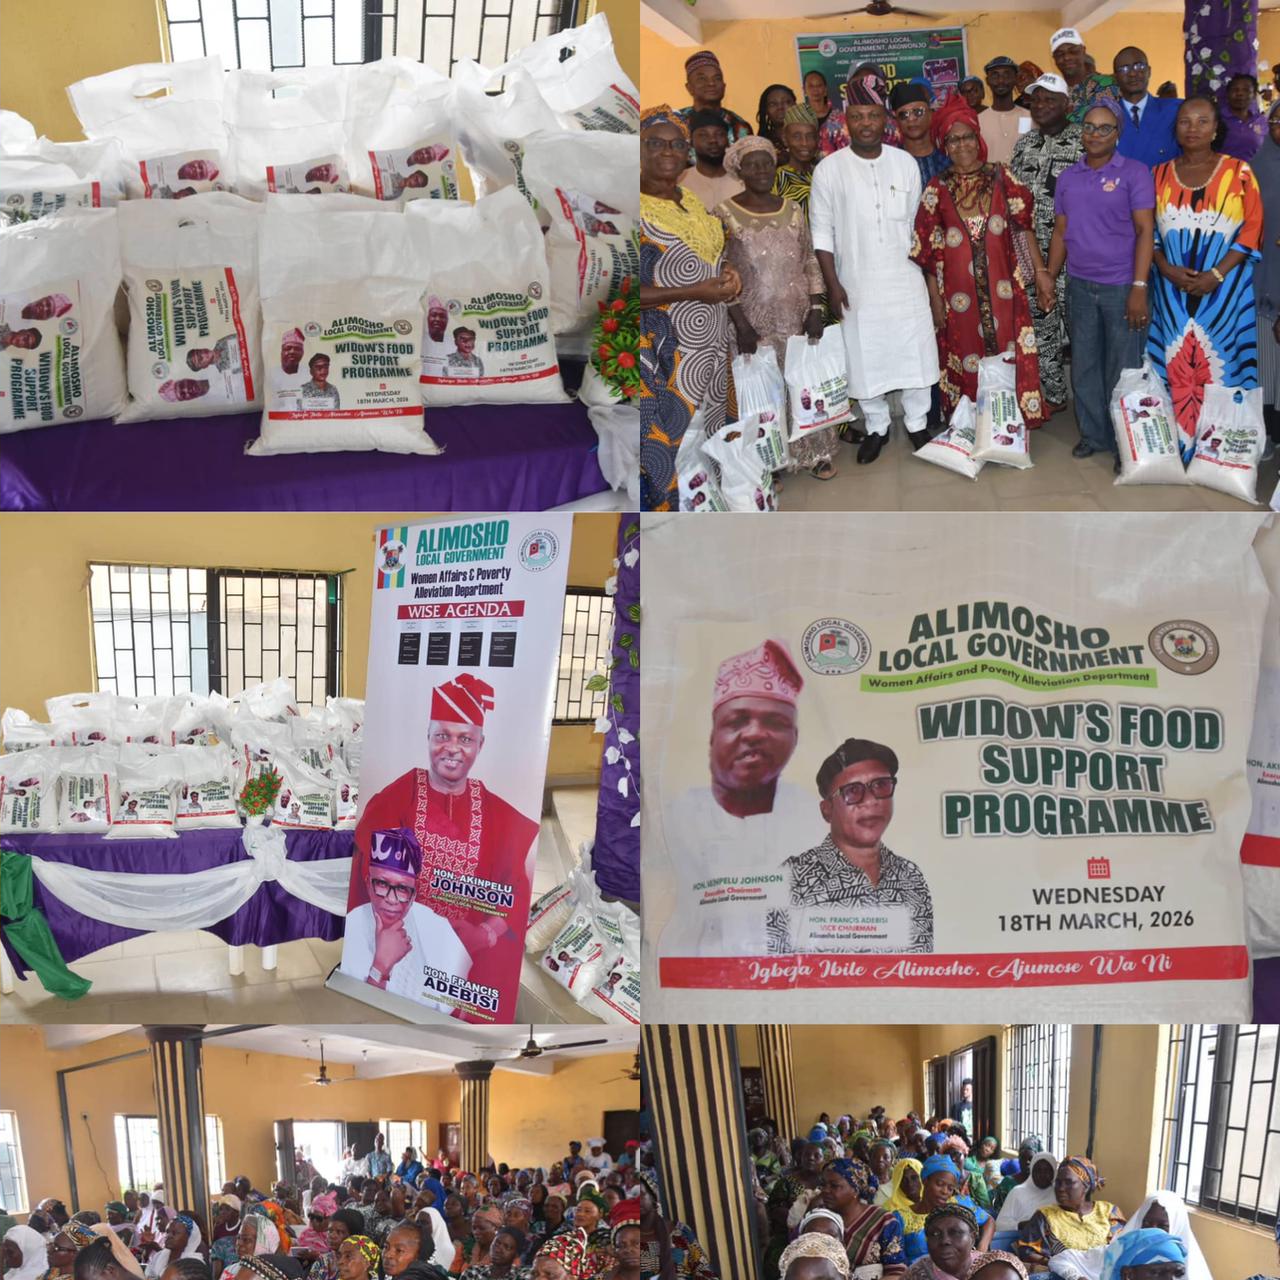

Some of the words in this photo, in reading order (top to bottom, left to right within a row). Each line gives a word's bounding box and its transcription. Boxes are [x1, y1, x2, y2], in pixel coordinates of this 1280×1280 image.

[182, 287, 197, 330] SUPPORT
[192, 280, 209, 337] PROGRAMME
[471, 292, 523, 304] ALIMOSHO
[146, 296, 158, 352] ALIMOSHO
[324, 327, 345, 336] LOCAL
[347, 324, 393, 335] GOVERNMENT
[331, 316, 384, 329] ALIMOSHO
[479, 316, 527, 329] WIDOW'S
[527, 308, 549, 322] FOOD
[495, 323, 540, 340] SUPPORT
[62, 338, 70, 360] LOCAL
[158, 336, 166, 360] LOCAL
[335, 342, 384, 354] WIDOW'S
[386, 343, 413, 354] FOOD
[352, 354, 399, 366] SUPPORT
[71, 345, 82, 398] ALIMOSHO
[342, 367, 412, 378] PROGRAMME
[10, 358, 26, 420] PROGRAMME
[24, 368, 38, 412] SUPPORT
[416, 519, 510, 554] ALIMOSHO
[416, 551, 441, 566] LOCAL
[444, 547, 506, 564] GOVERNMENT
[411, 571, 438, 585] Women
[439, 570, 467, 584] Affairs
[476, 566, 512, 583] Poverty
[414, 585, 453, 599] Alleviation
[455, 583, 503, 598] Department
[408, 605, 440, 618] WISE
[445, 603, 512, 618] AGENDA
[907, 600, 1110, 650] ALIMOSHO
[818, 619, 842, 628] LOCAL
[844, 623, 868, 664] GOVERNMENT
[878, 638, 959, 672] LOCAL
[967, 632, 1145, 673] GOVERNMENT
[869, 678, 914, 688] Women
[916, 672, 954, 685] Affairs
[956, 664, 978, 677] and
[980, 664, 1021, 683] Poverty
[1022, 674, 1080, 687] Alleviation
[1084, 672, 1150, 683] Department
[919, 698, 1111, 743] WIDOW'S
[1119, 705, 1222, 751] FOOD
[981, 745, 1164, 793] SUPPORT
[942, 794, 1214, 837] PROGRAMME
[433, 868, 457, 881] HON.
[460, 874, 513, 893] AKINPELU
[727, 886, 762, 894] Chairman
[740, 874, 783, 885] JOHNSON
[431, 877, 514, 908] JOHNSON
[1032, 886, 1166, 905] WEDNESDAY
[830, 916, 859, 924] FRANCIS
[998, 914, 1052, 931] 18TH
[1059, 911, 1144, 931] MARCH,
[1150, 910, 1194, 928] 2026
[819, 960, 868, 979] Ibile
[987, 958, 1083, 981] Ajumose
[1090, 955, 1137, 975] Wa
[1141, 953, 1172, 973] Ni
[423, 965, 449, 982] HON.
[451, 974, 499, 998] FRANCIS
[424, 976, 498, 1012] ADEBISI
